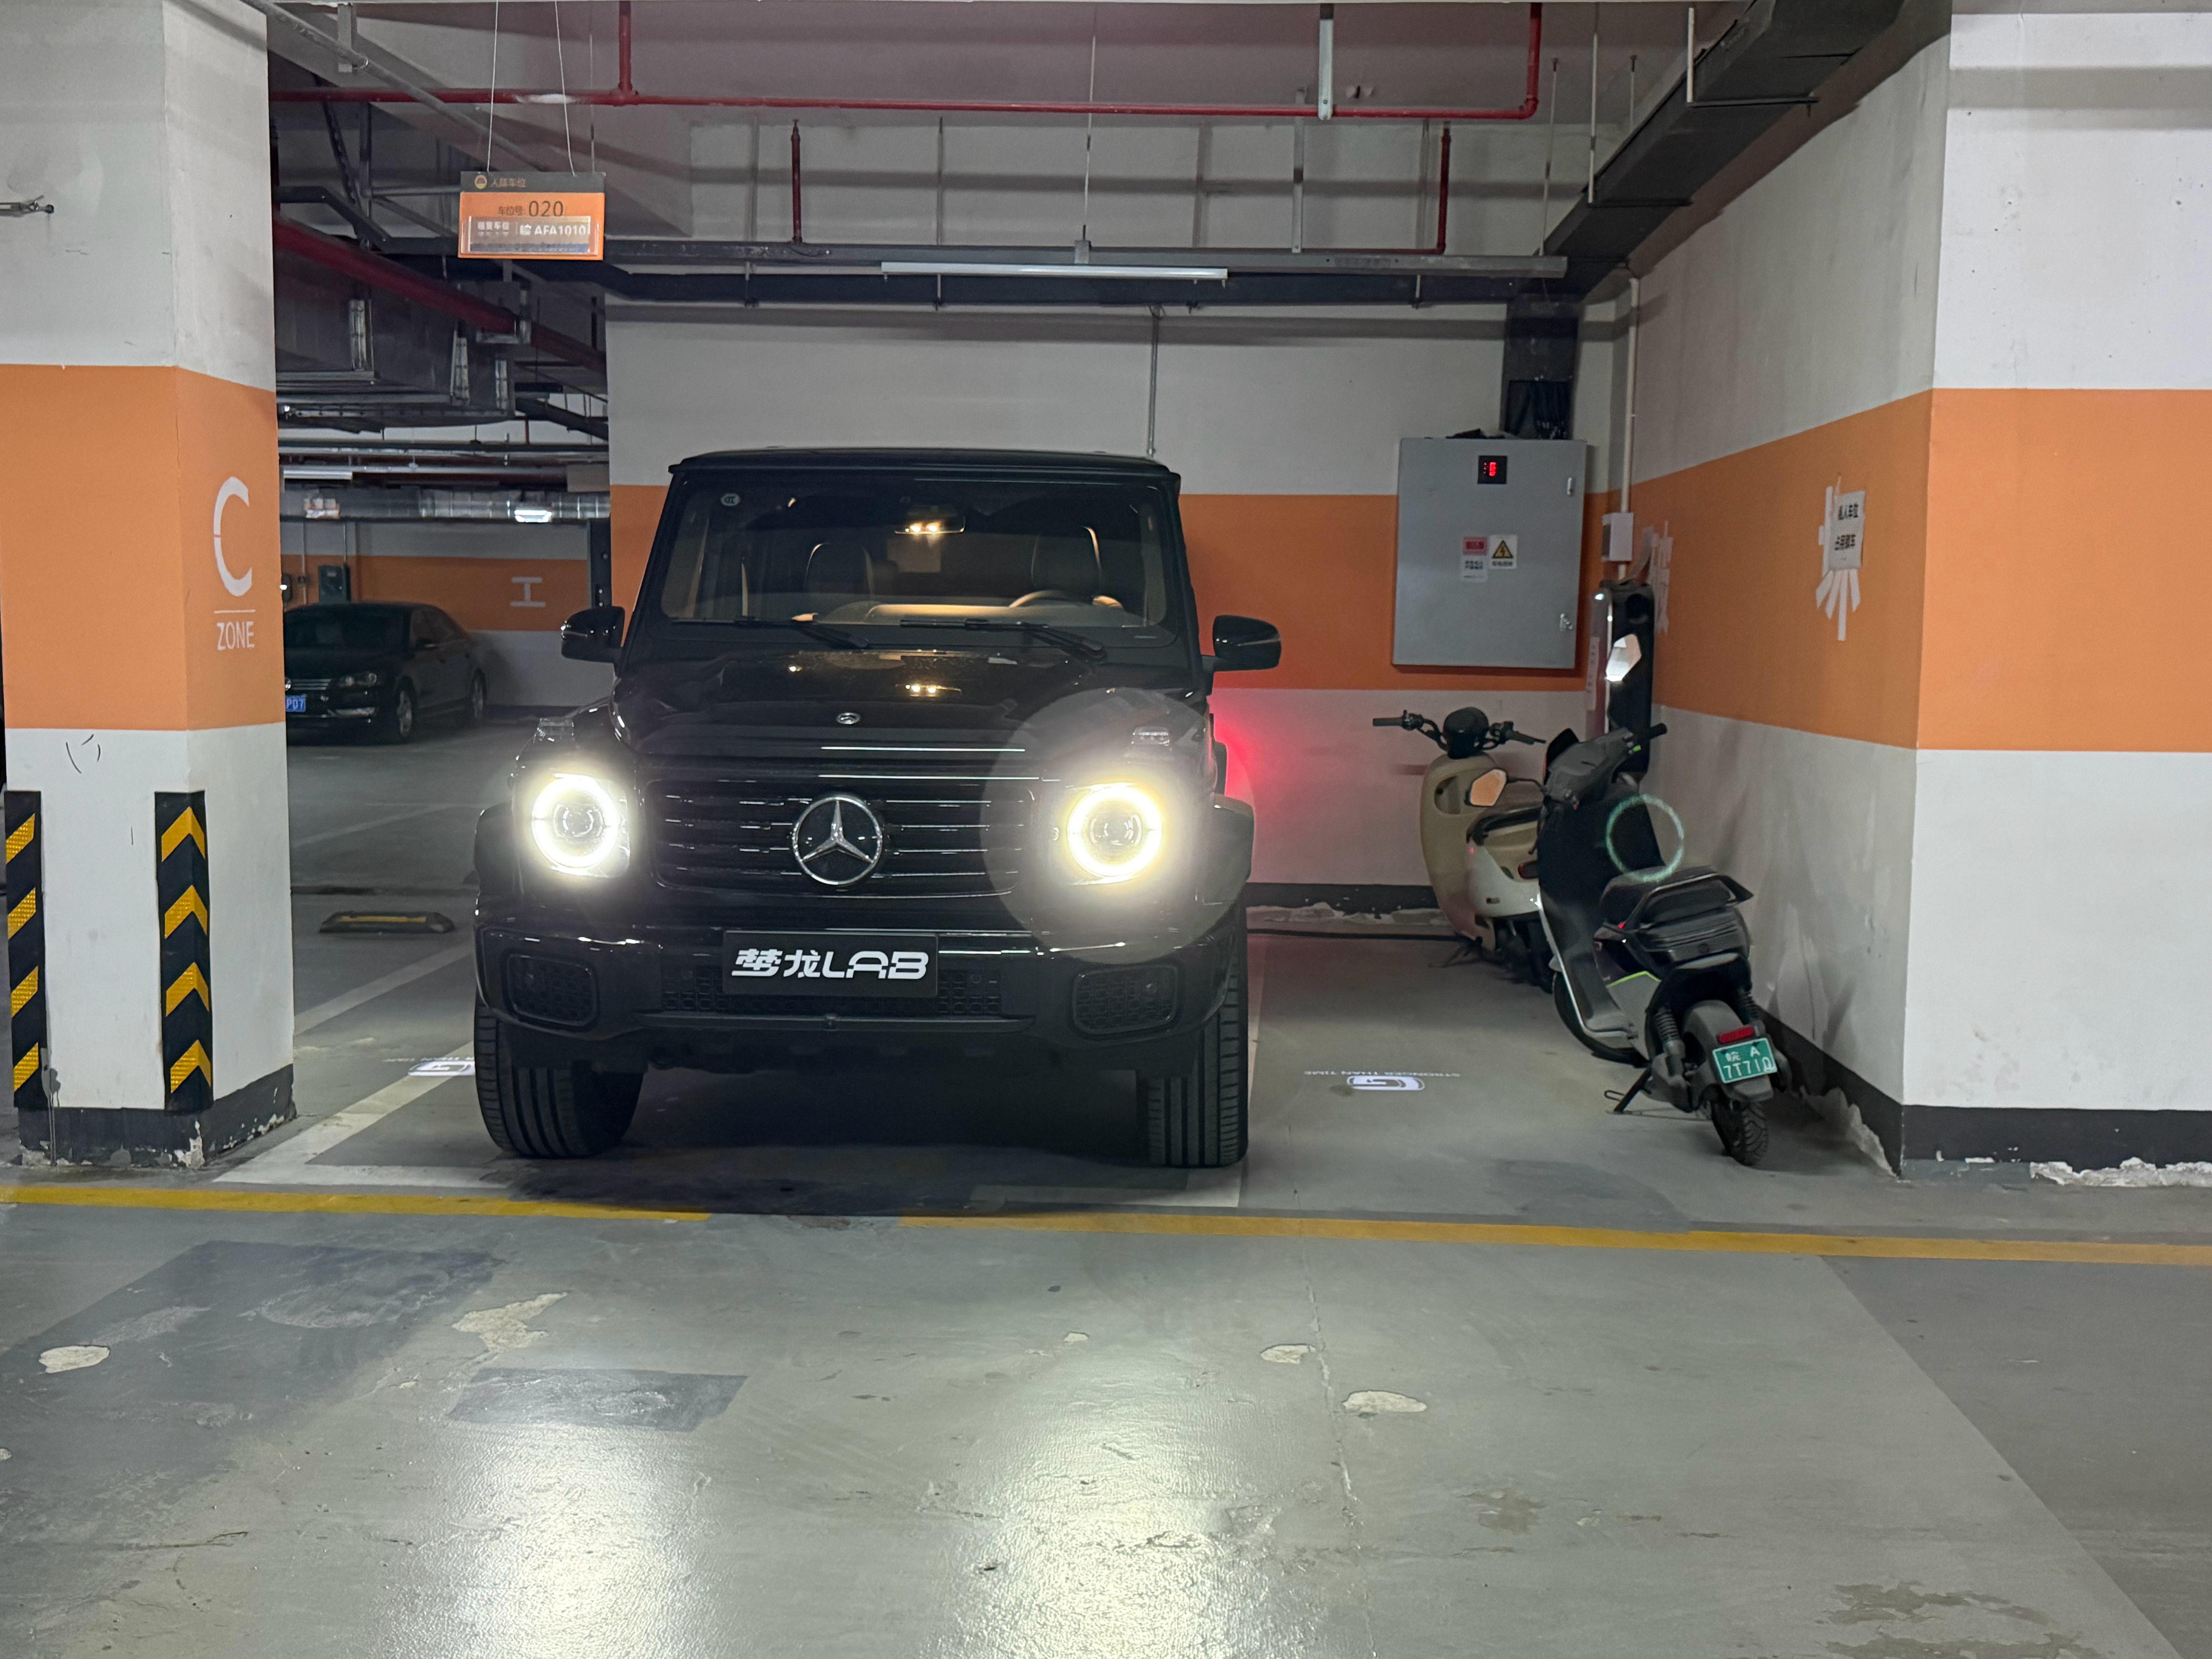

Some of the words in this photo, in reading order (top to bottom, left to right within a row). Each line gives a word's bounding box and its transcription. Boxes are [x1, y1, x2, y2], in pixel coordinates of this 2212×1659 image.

[529, 200, 563, 216] 020
[213, 476, 252, 597] C
[216, 621, 255, 651] ZONE
[732, 948, 929, 980] 梦龙LAB
[1750, 1046, 1760, 1057] A
